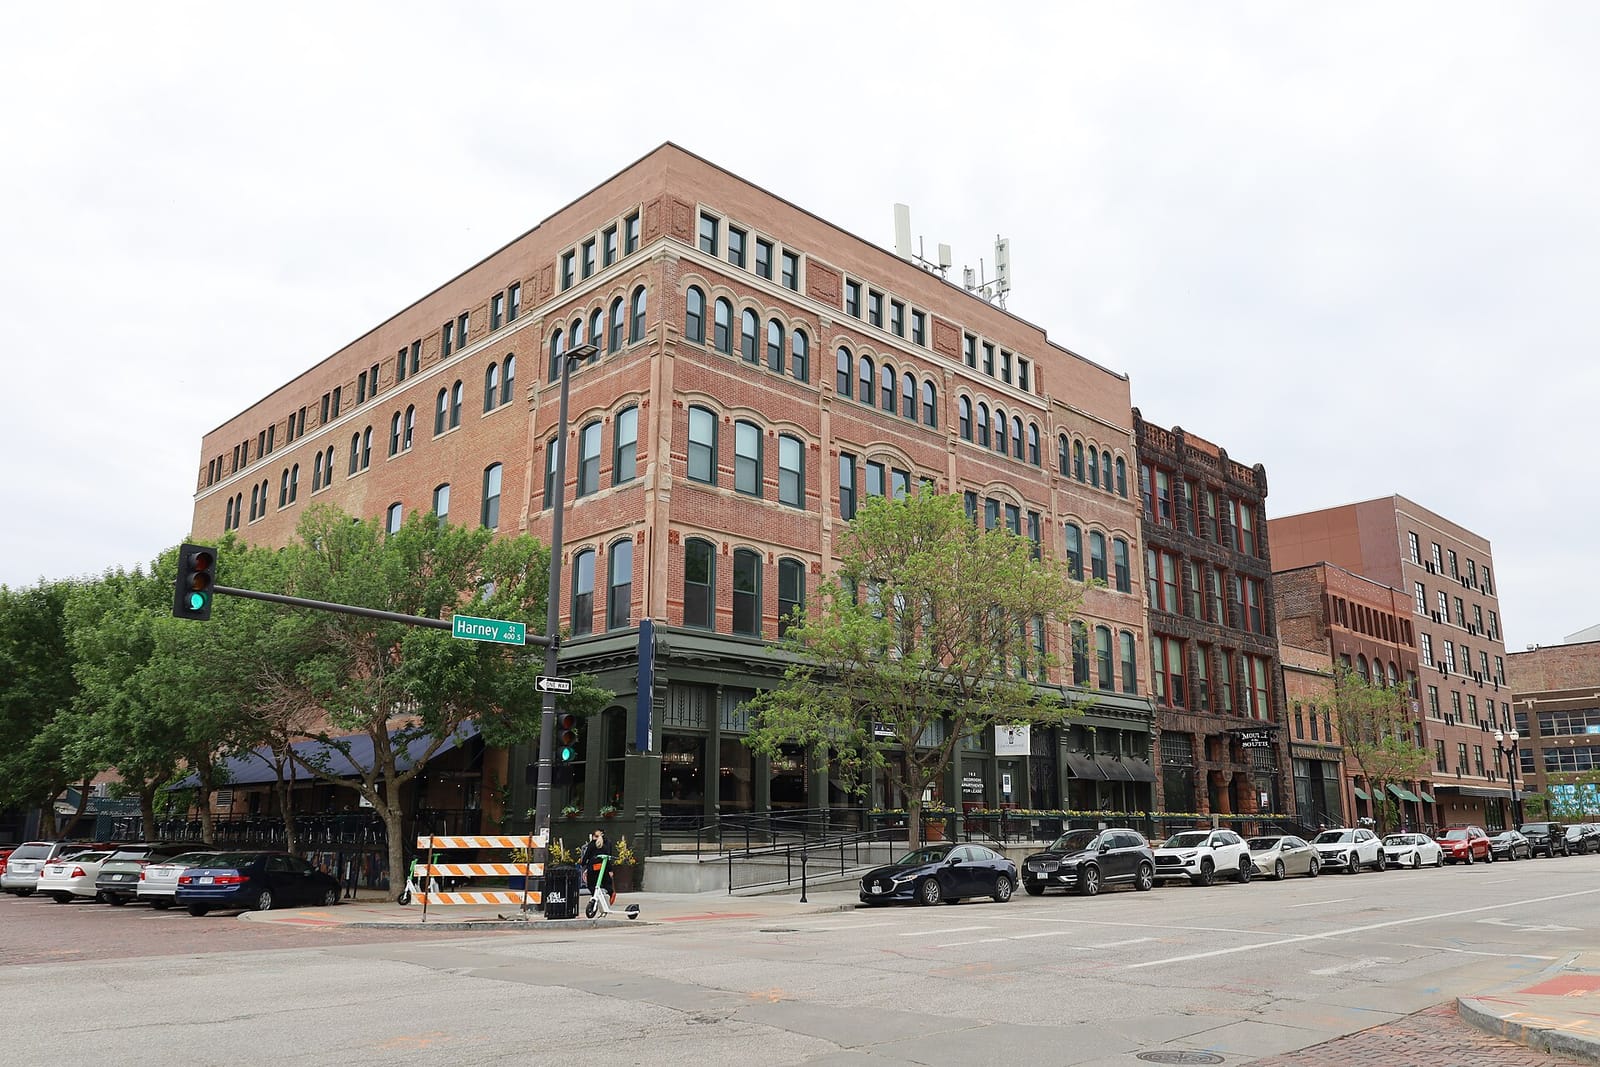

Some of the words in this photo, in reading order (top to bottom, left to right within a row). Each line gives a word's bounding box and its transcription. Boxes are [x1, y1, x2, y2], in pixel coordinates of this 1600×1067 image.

[457, 620, 498, 639] Harney
[508, 625, 516, 633] St
[503, 632, 515, 640] 400
[546, 680, 556, 688] ONE
[557, 681, 569, 689] WAY
[549, 891, 560, 899] Old
